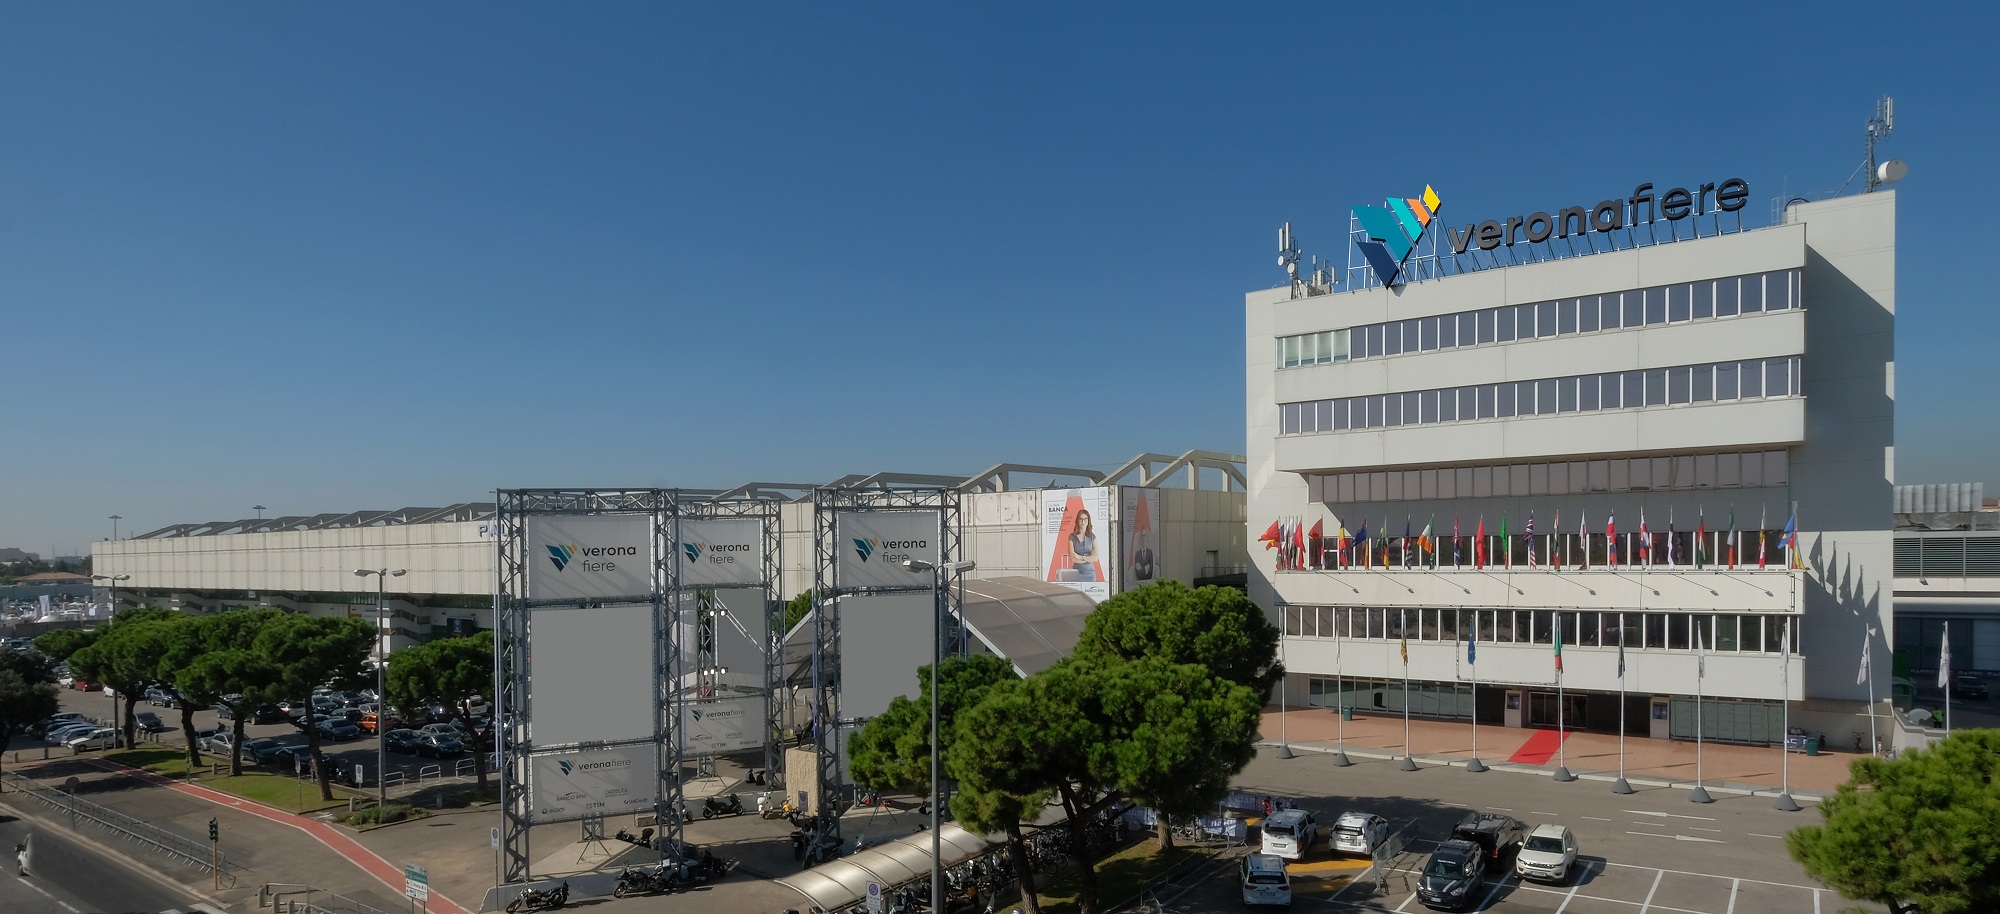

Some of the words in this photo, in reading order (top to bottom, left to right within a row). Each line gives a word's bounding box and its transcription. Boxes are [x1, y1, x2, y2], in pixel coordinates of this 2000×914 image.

[1449, 178, 1749, 254] veronafiere
[709, 544, 750, 552] verona
[882, 540, 926, 549] verona
[582, 546, 636, 556] verona
[710, 554, 734, 564] fiere
[882, 552, 910, 562] fiere
[582, 560, 616, 572] fiere
[578, 758, 632, 770] veronafiere
